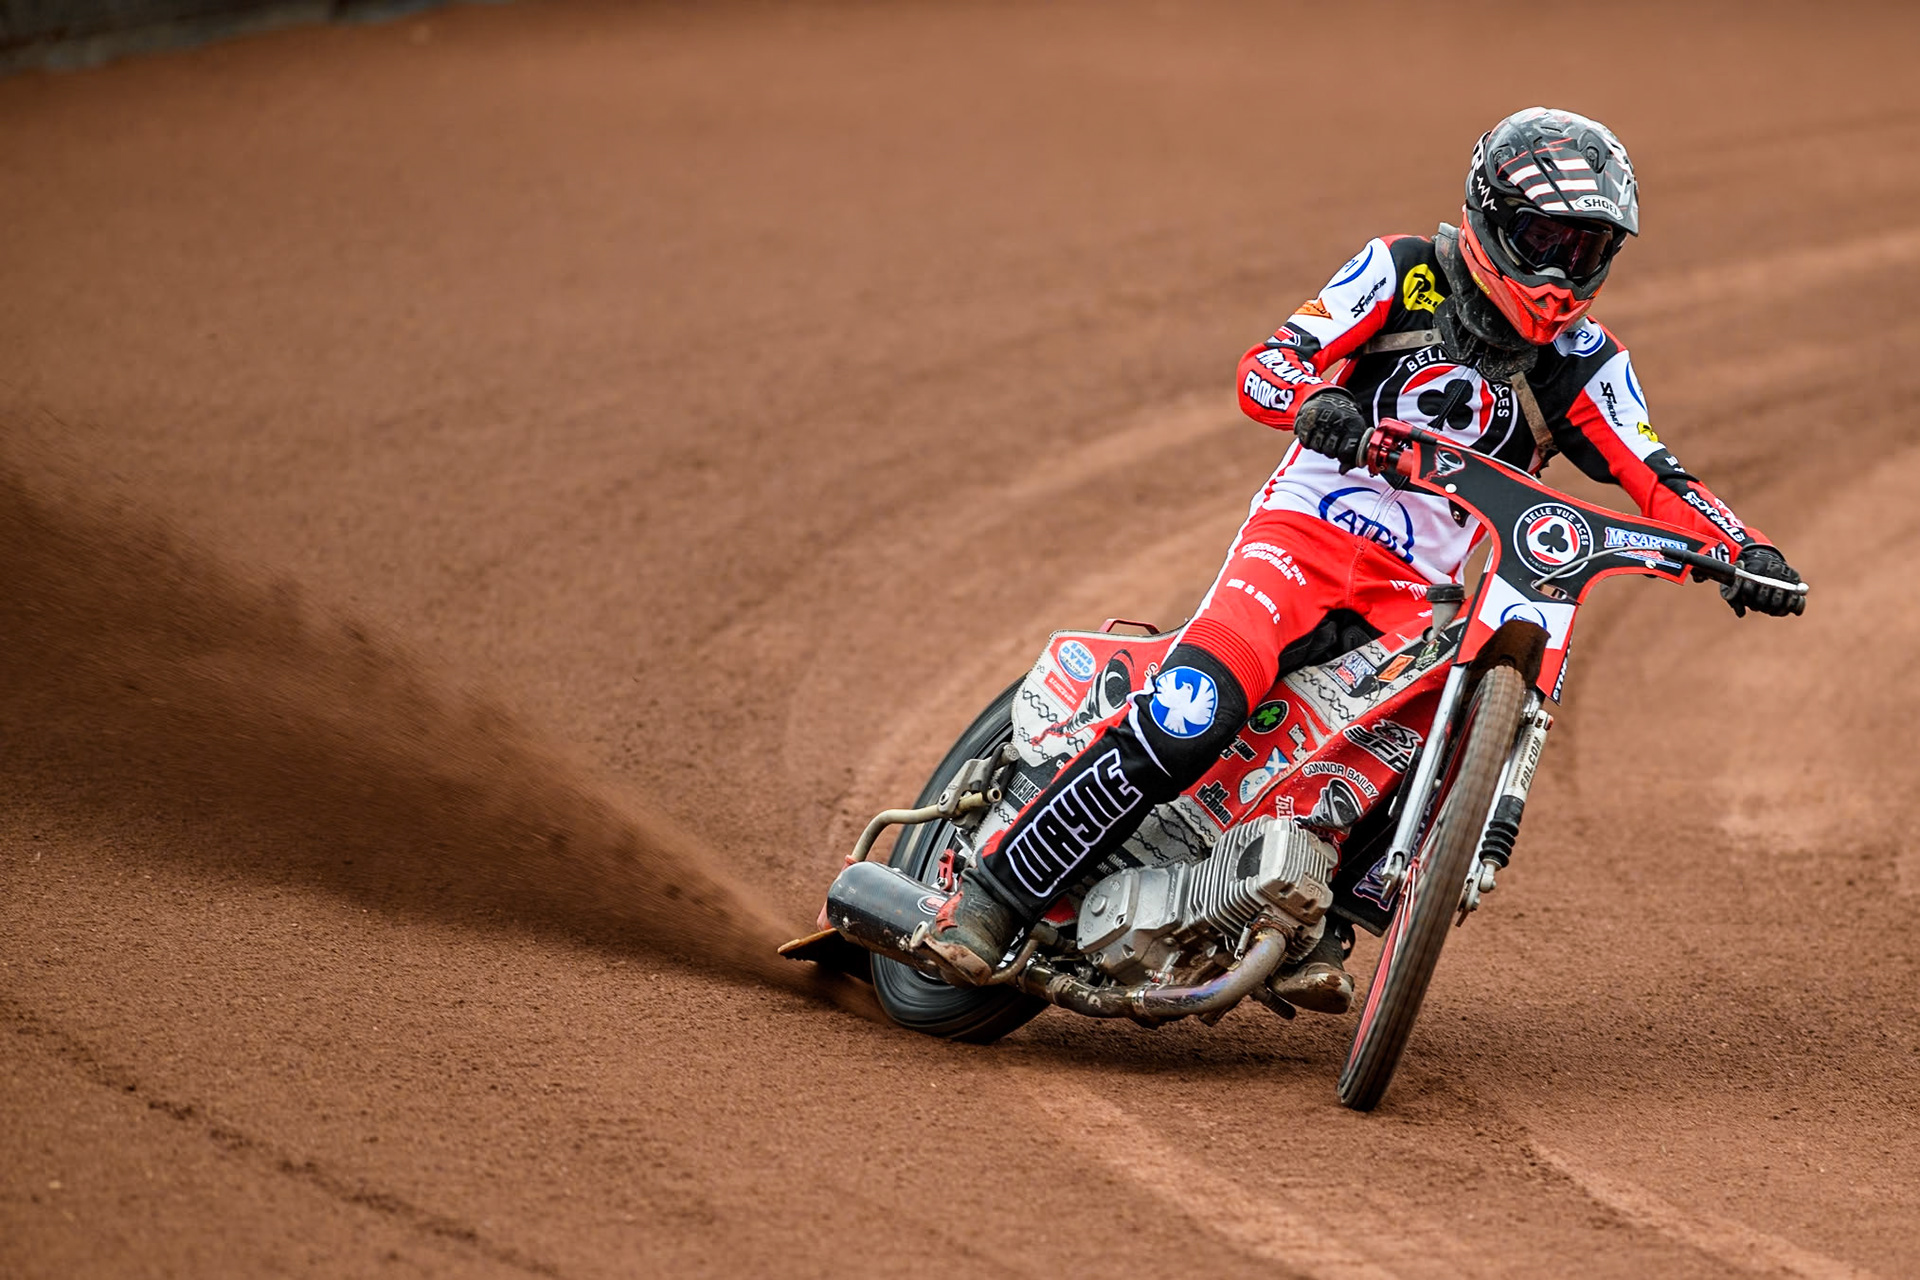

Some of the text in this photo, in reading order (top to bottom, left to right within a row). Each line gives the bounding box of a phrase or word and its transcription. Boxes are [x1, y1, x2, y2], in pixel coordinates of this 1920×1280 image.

[1584, 198, 1619, 217] SHOEI
[1524, 507, 1589, 546] BELLE VUE ACES
[1243, 550, 1293, 581] CHAPMAN
[1290, 563, 1307, 586] PAT
[1244, 583, 1255, 595] &
[1254, 589, 1278, 615] MRS
[1303, 762, 1378, 799] CONNOR BAILEY
[1520, 736, 1541, 791] FALCON
[1005, 747, 1144, 898] WAYNE
